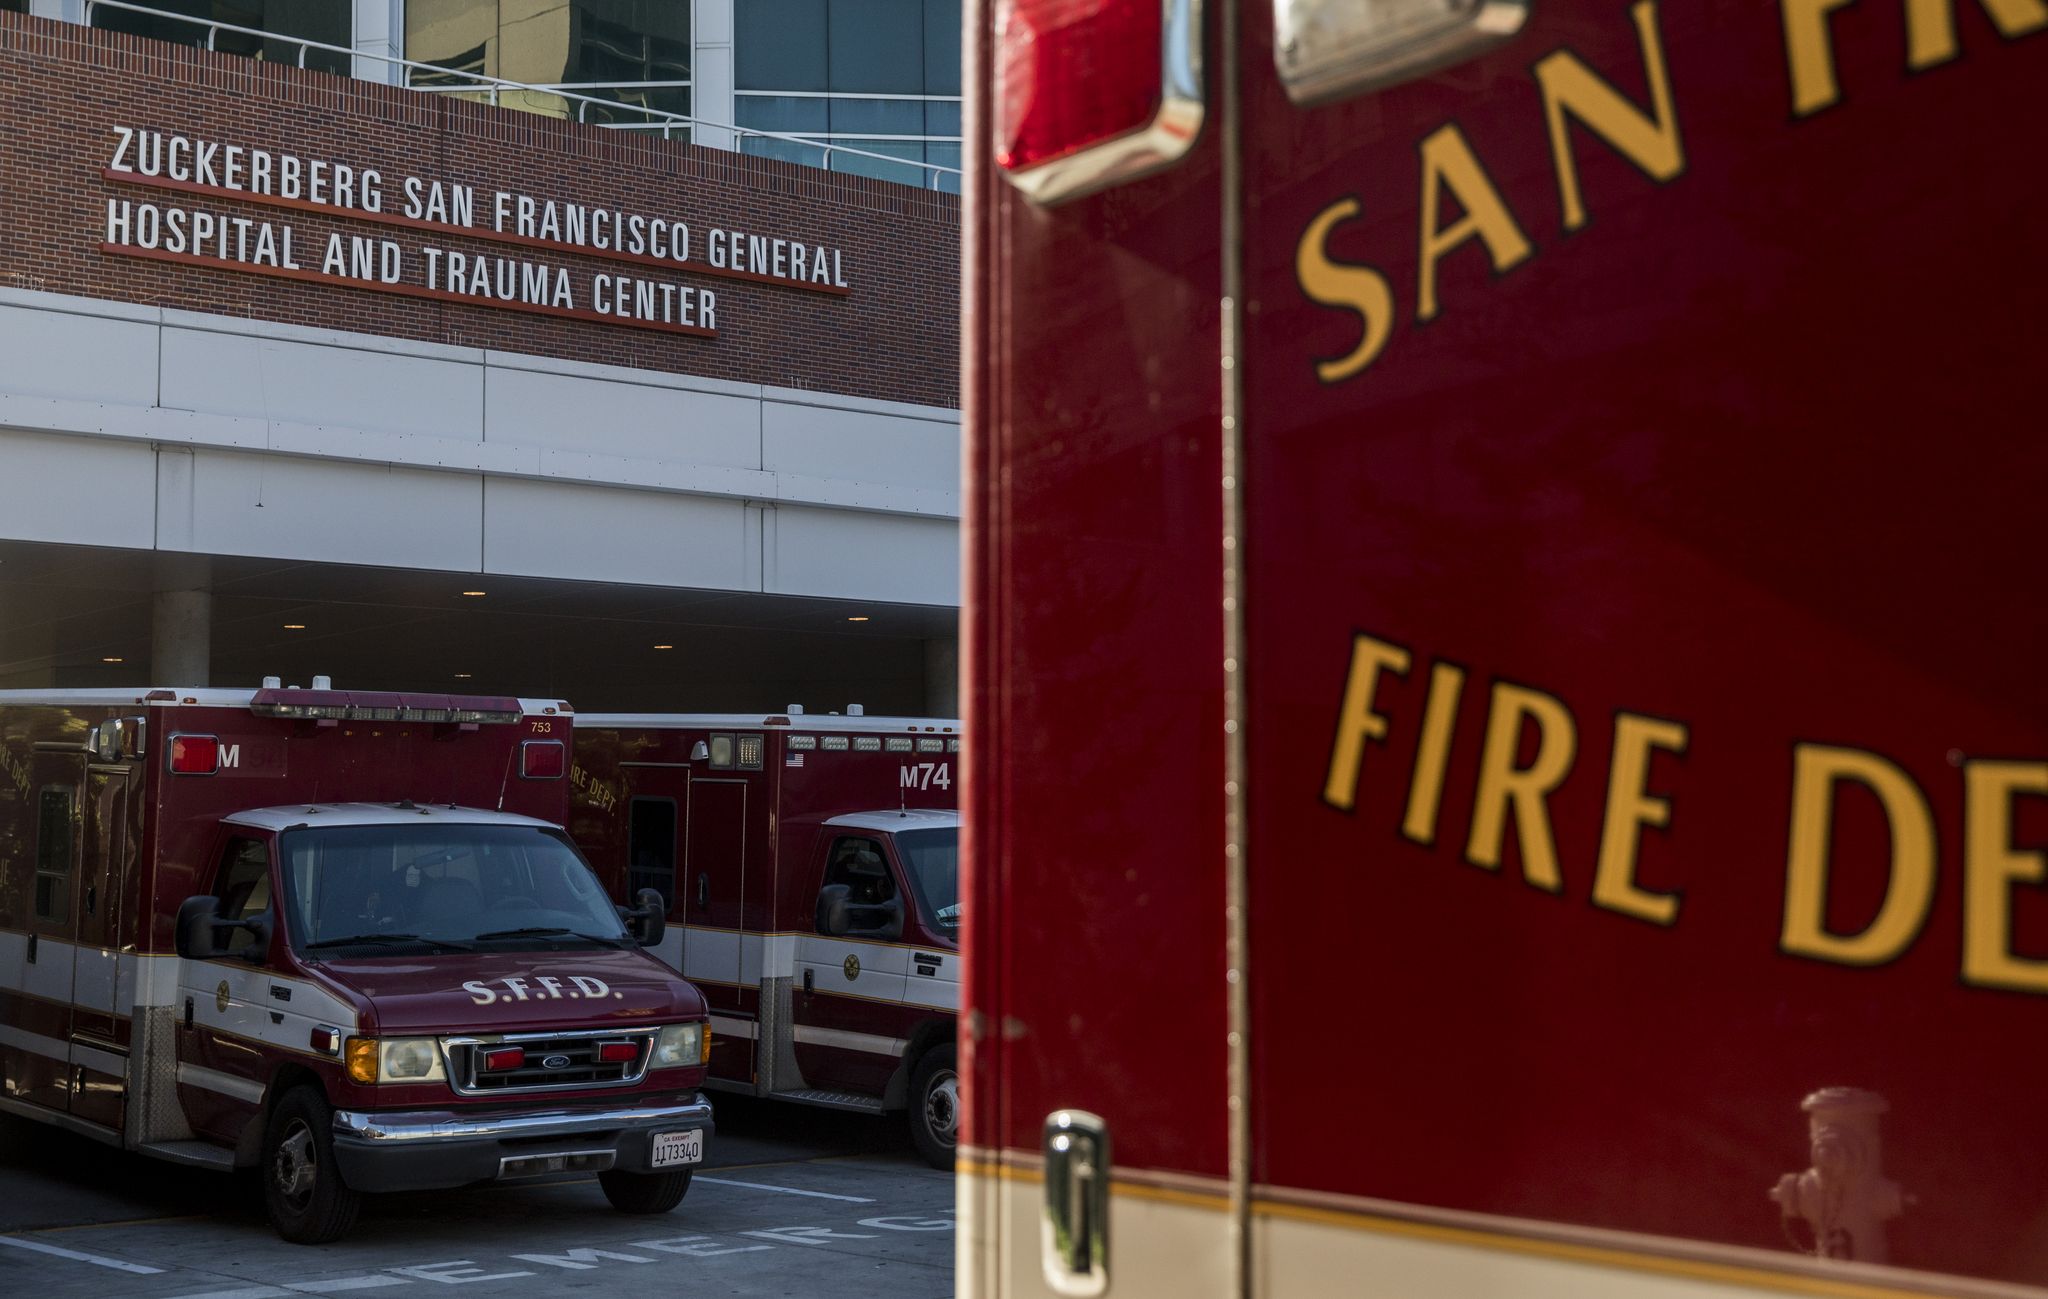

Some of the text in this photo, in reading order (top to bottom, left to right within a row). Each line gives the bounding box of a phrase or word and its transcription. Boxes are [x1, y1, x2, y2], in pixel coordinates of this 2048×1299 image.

[1296, 0, 1687, 383] SAN
[111, 126, 848, 288] ZUCKERBERG SAN FRANCISCO GENERAL
[107, 199, 716, 329] HOSPITAL AND TRAUMA CENTER
[531, 721, 551, 733] 753
[218, 744, 240, 768] M
[570, 763, 588, 788] IRE
[900, 763, 951, 791] M74
[1323, 631, 2048, 994] FIRE DE
[462, 976, 624, 1005] S.F.F.D.
[671, 1134, 690, 1142] EXEMPT
[655, 1142, 699, 1164] 1173340
[390, 1209, 956, 1284] EMERG
